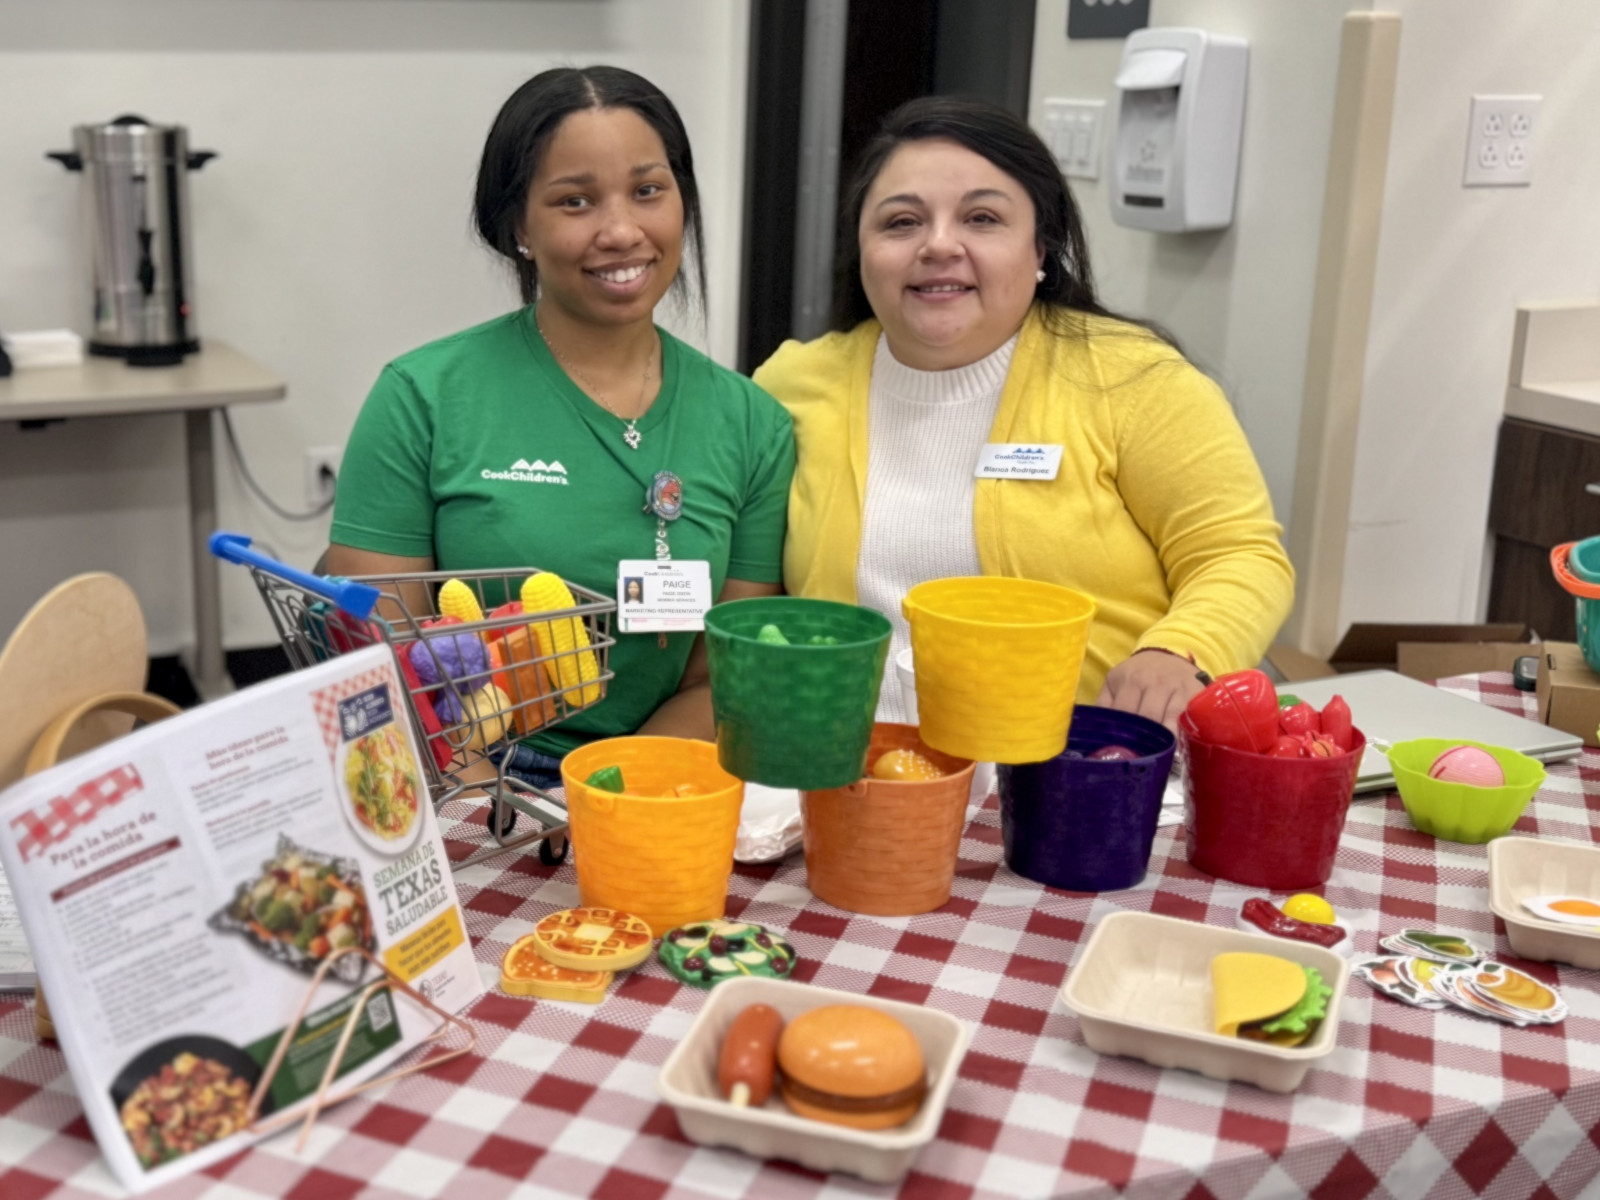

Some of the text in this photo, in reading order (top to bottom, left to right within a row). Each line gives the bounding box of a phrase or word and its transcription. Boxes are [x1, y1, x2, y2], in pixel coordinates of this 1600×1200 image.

[663, 580, 691, 589] PAIGE
[50, 811, 157, 866] Para la hora de
[72, 831, 144, 870] la comida
[373, 840, 436, 889] SEMANA DE
[378, 858, 442, 916] TEXAS
[386, 885, 448, 936] SALUDABLE
